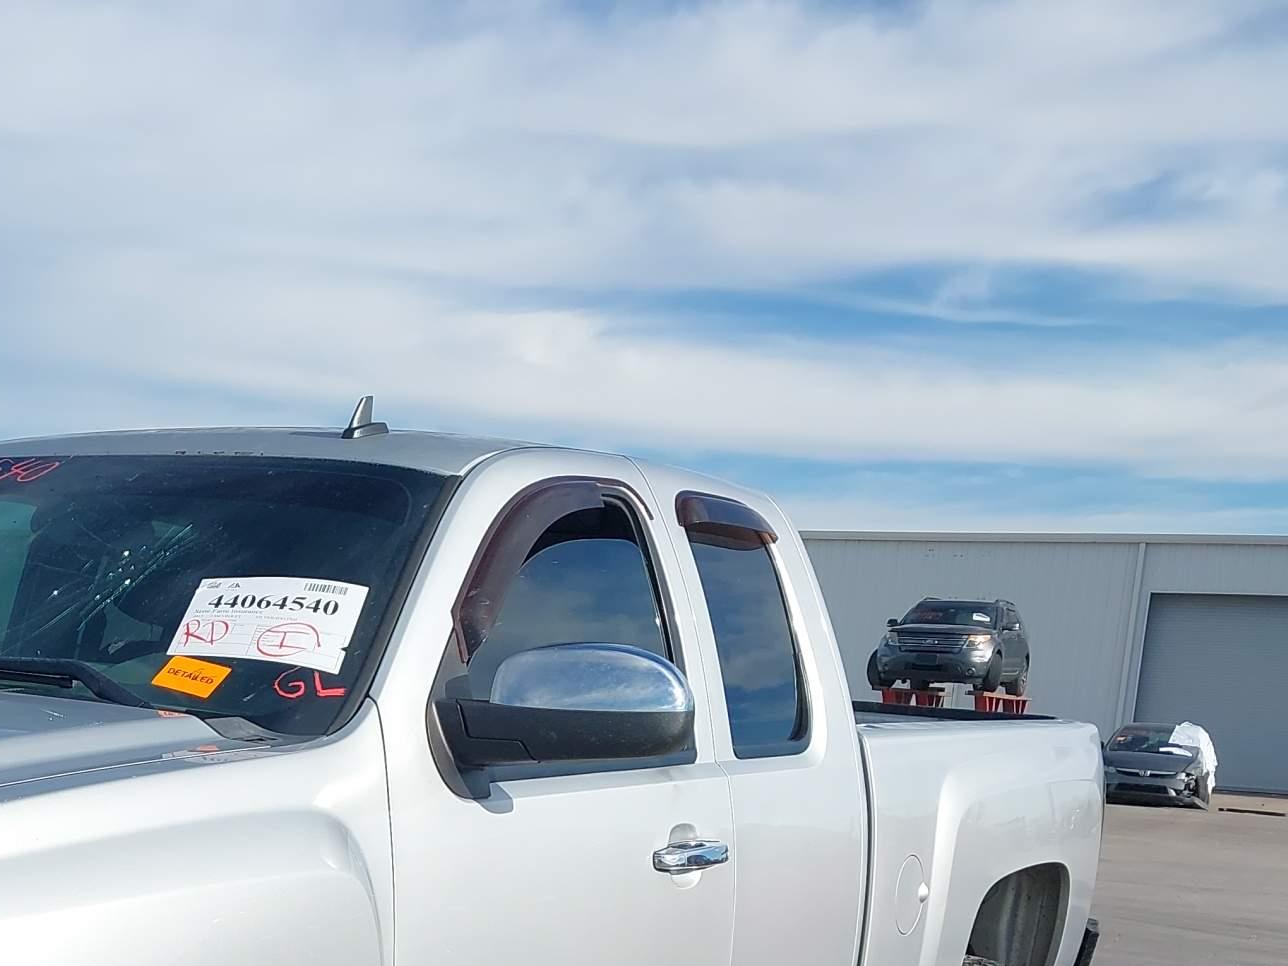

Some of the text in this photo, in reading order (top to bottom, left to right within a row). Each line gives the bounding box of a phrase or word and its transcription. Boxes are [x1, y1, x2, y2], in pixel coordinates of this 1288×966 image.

[208, 594, 339, 616] 44064540
[184, 619, 229, 647] RD
[167, 667, 214, 685] DETAILED
